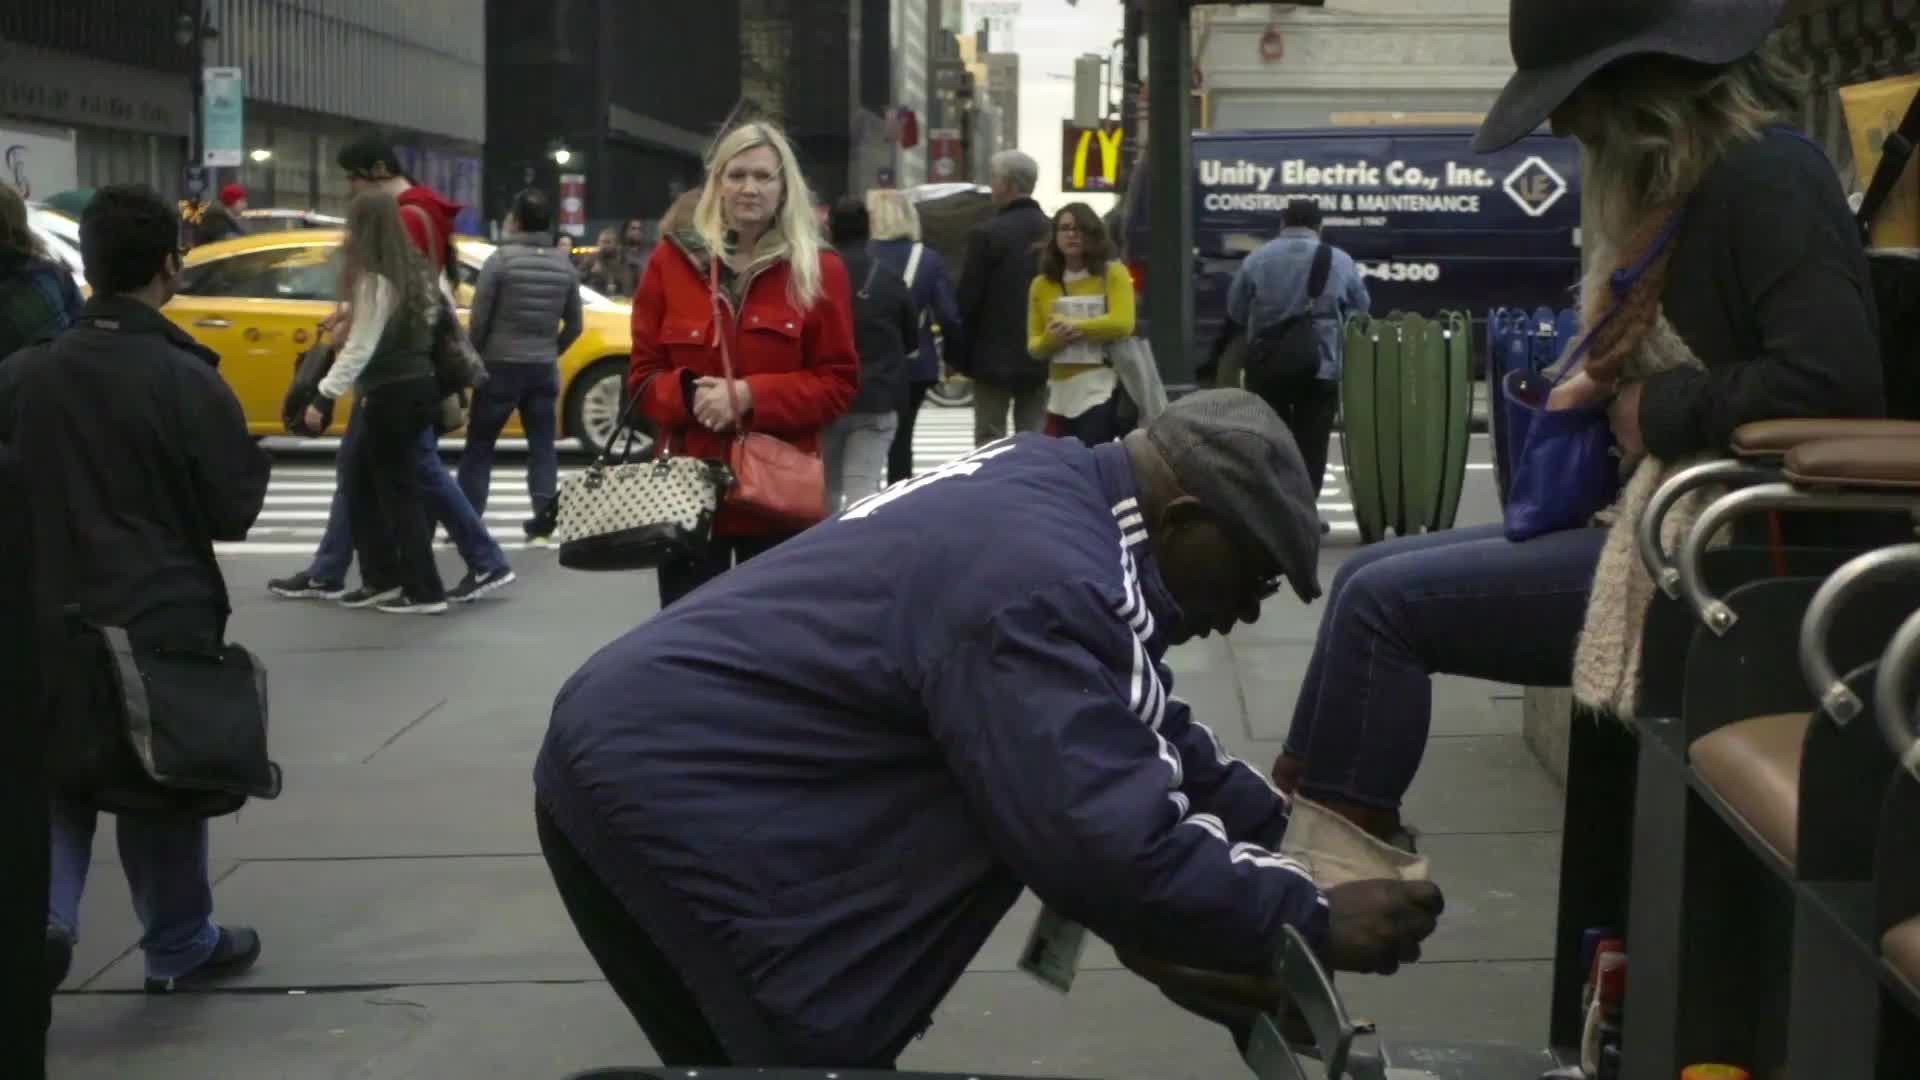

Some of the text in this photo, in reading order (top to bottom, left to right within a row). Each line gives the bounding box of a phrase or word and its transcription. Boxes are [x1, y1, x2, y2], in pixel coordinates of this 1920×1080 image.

[1200, 160, 1275, 191] Unity
[1281, 159, 1380, 186] Electric
[1446, 161, 1494, 187] Inc.
[1204, 193, 1480, 213] CONSTRUON & MAINTENANCE
